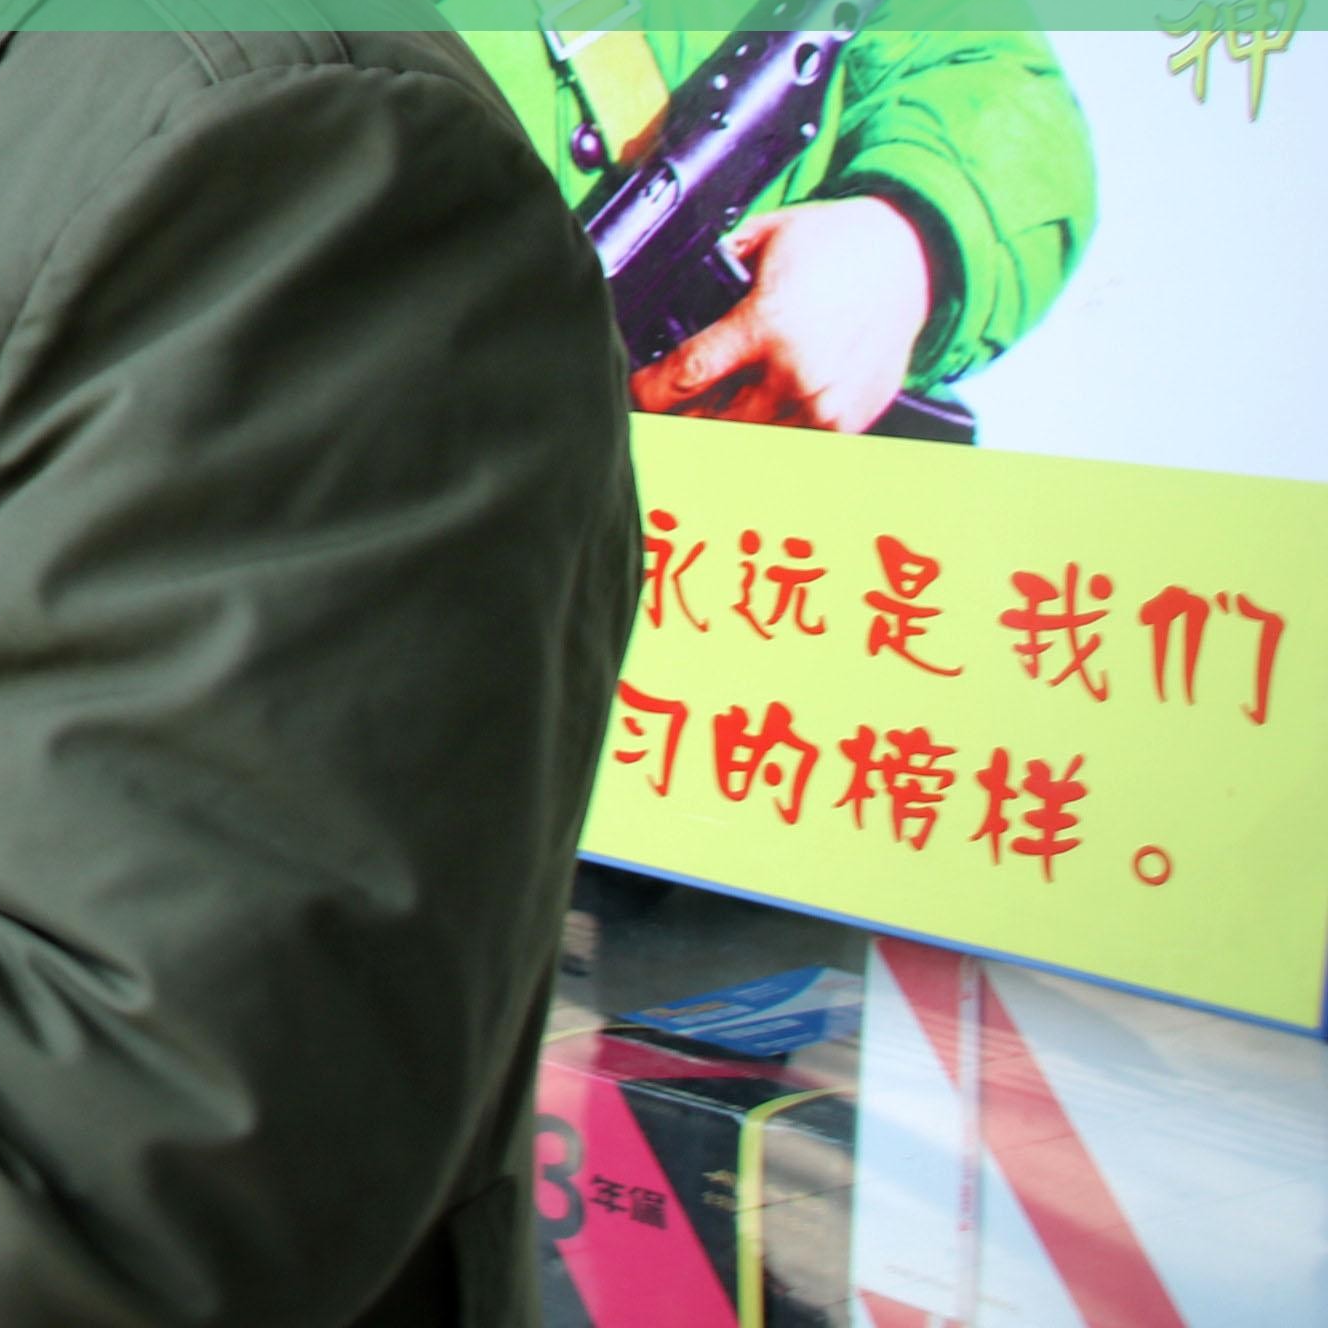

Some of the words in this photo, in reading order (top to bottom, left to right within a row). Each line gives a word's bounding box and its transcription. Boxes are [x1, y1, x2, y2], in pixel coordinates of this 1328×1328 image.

[641, 509, 1286, 726] 永远是我们
